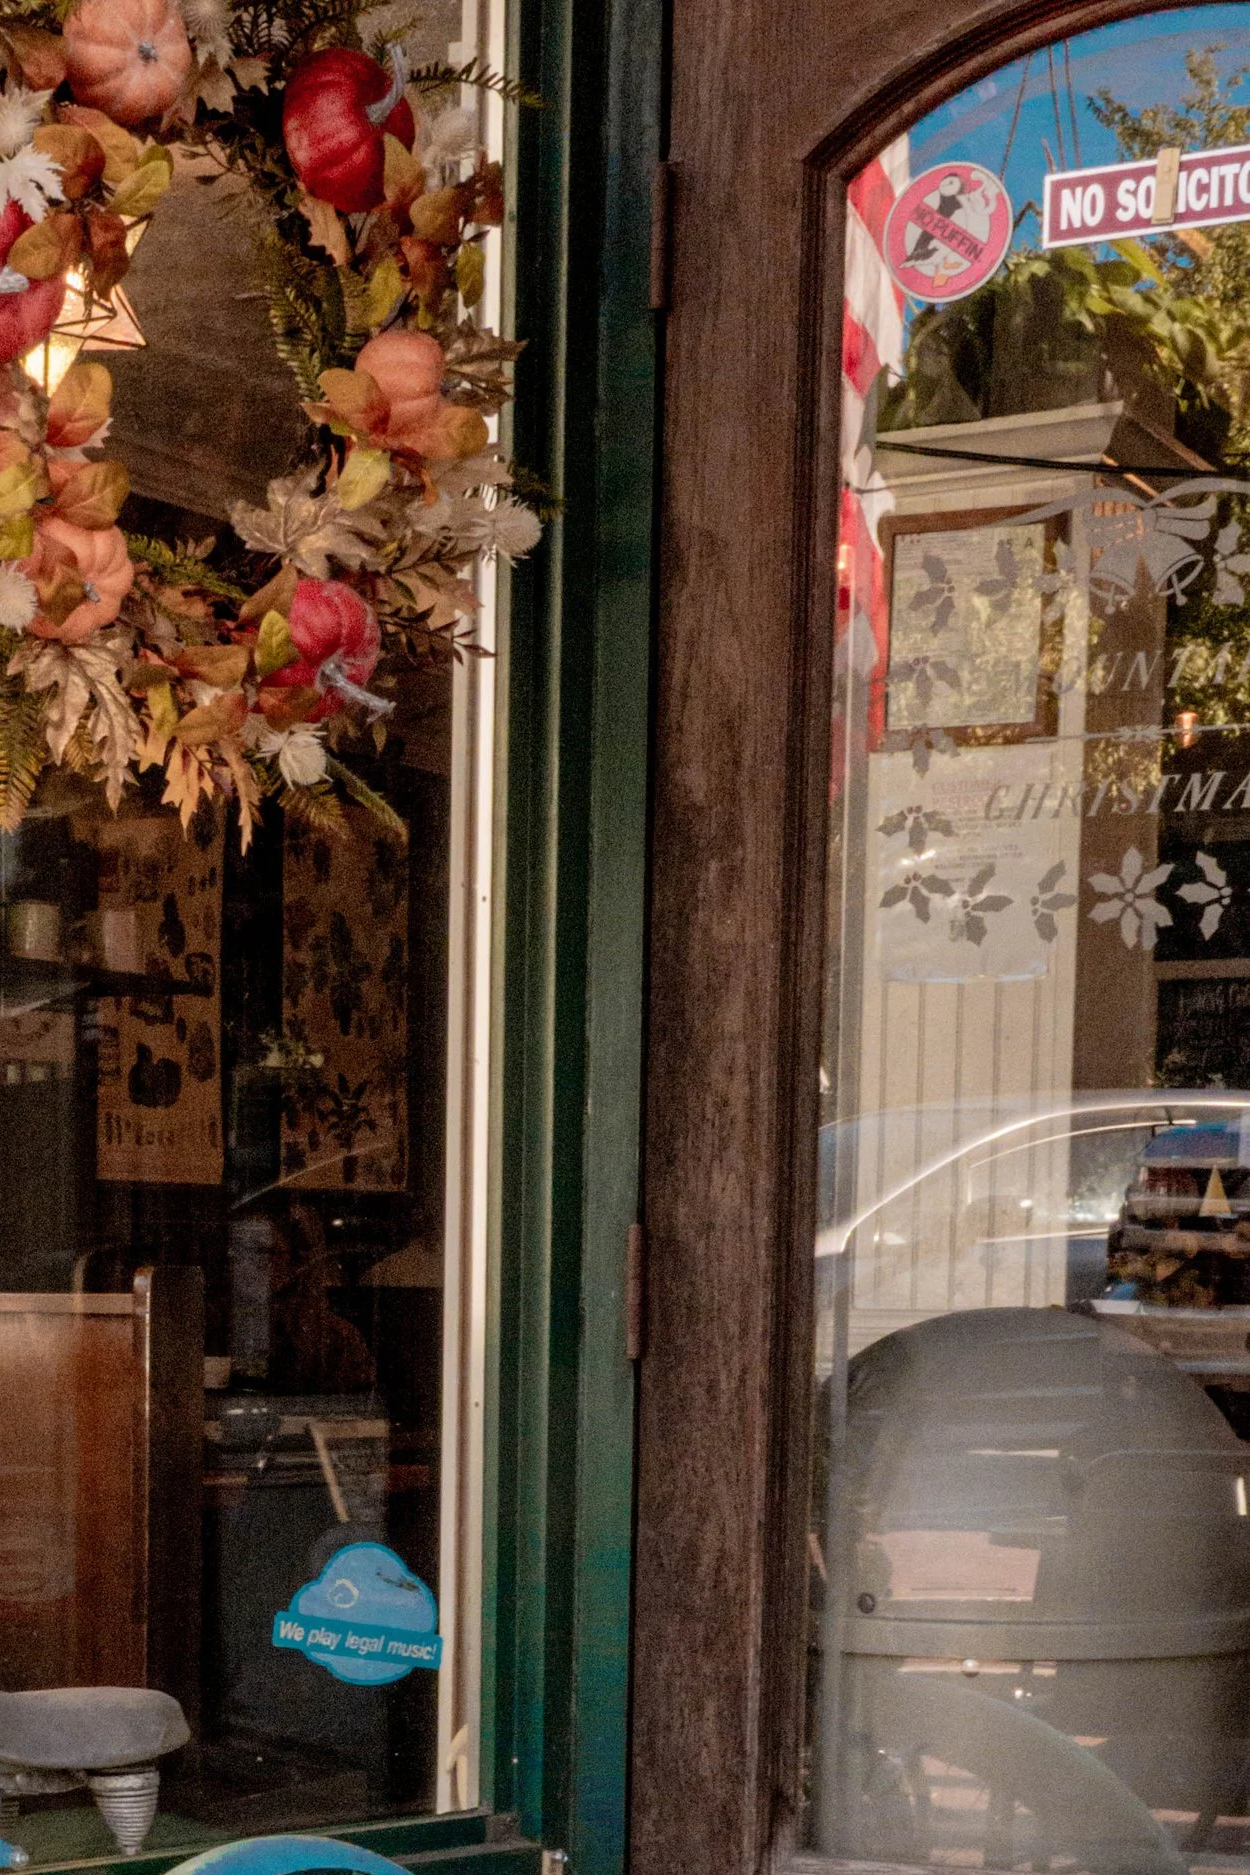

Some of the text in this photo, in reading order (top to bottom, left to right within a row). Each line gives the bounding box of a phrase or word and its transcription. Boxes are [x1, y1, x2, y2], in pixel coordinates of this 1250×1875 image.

[1059, 160, 1250, 230] NO SOICITO
[912, 203, 983, 260] NO PUFFIN
[279, 1620, 438, 1660] We play legal music!
